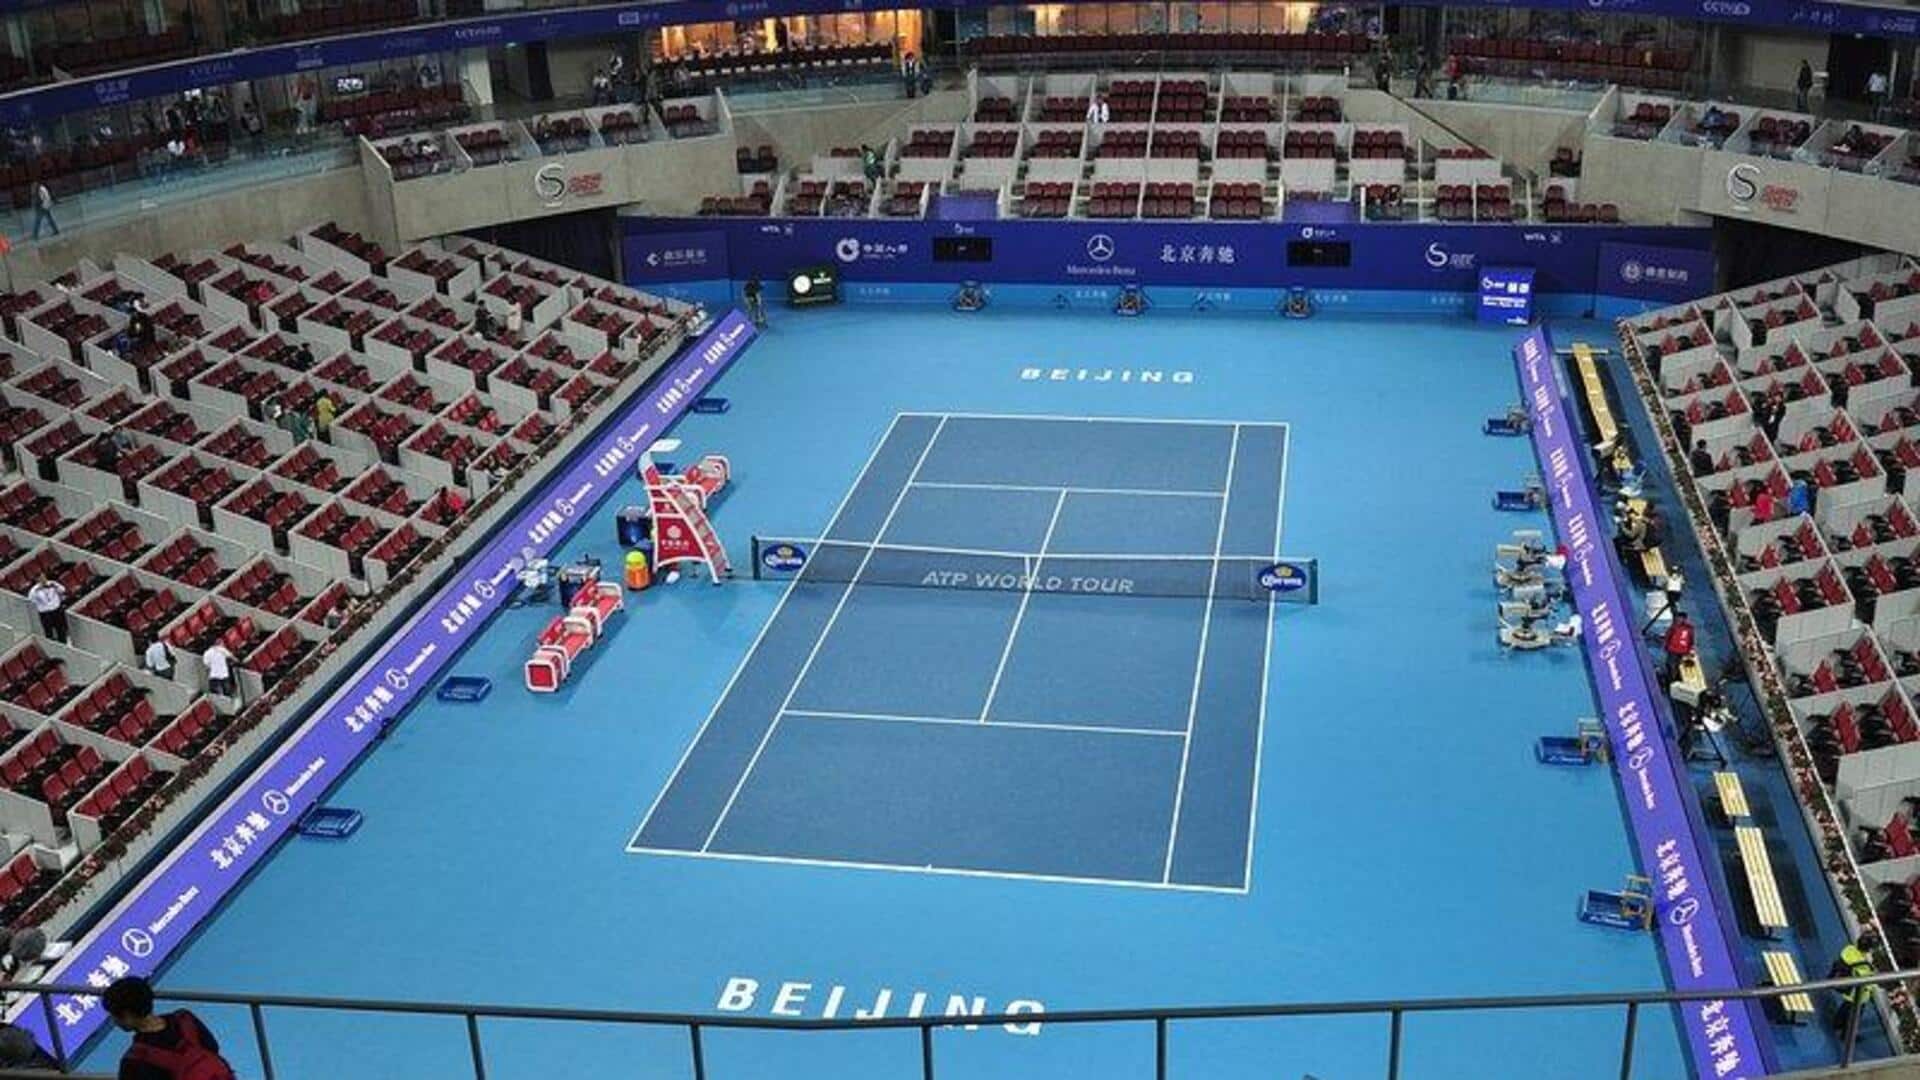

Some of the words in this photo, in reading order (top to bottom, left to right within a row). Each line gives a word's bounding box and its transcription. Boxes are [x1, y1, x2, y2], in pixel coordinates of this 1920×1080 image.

[1160, 244, 1235, 263] 北京奔驰
[1021, 368, 1194, 383] BEIJING
[921, 570, 968, 586] ATP
[974, 573, 1062, 591] WORLD
[1071, 577, 1134, 593] TOUR
[716, 977, 1046, 1035] BEIJING
